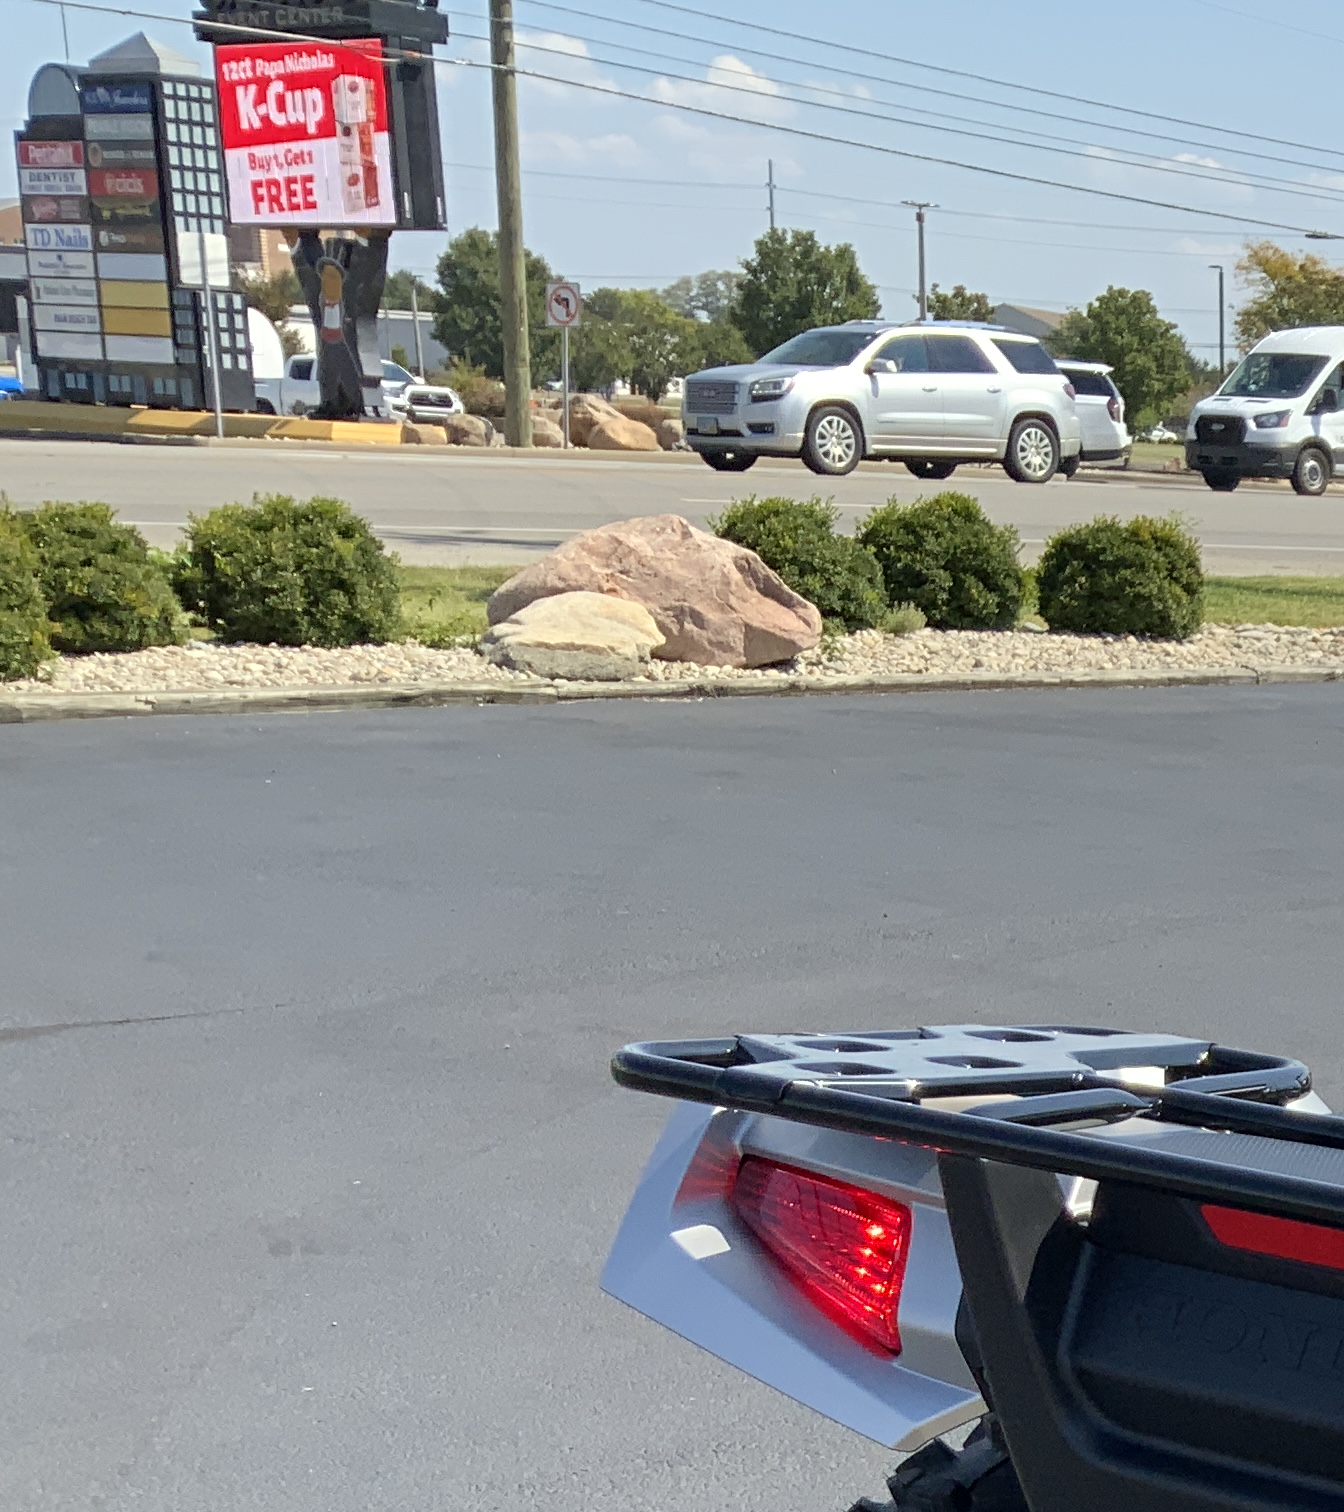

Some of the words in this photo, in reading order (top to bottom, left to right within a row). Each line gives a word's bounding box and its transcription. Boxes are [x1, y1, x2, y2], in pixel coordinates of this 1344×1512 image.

[275, 7, 343, 25] CENTER
[256, 58, 284, 78] Papa
[284, 50, 335, 73] Nicholas
[235, 80, 324, 134] K-Cup
[248, 152, 273, 172] Buy
[29, 171, 76, 183] DENTIST
[251, 175, 317, 214] FREE
[31, 228, 51, 247] TD
[54, 229, 89, 248] Nails
